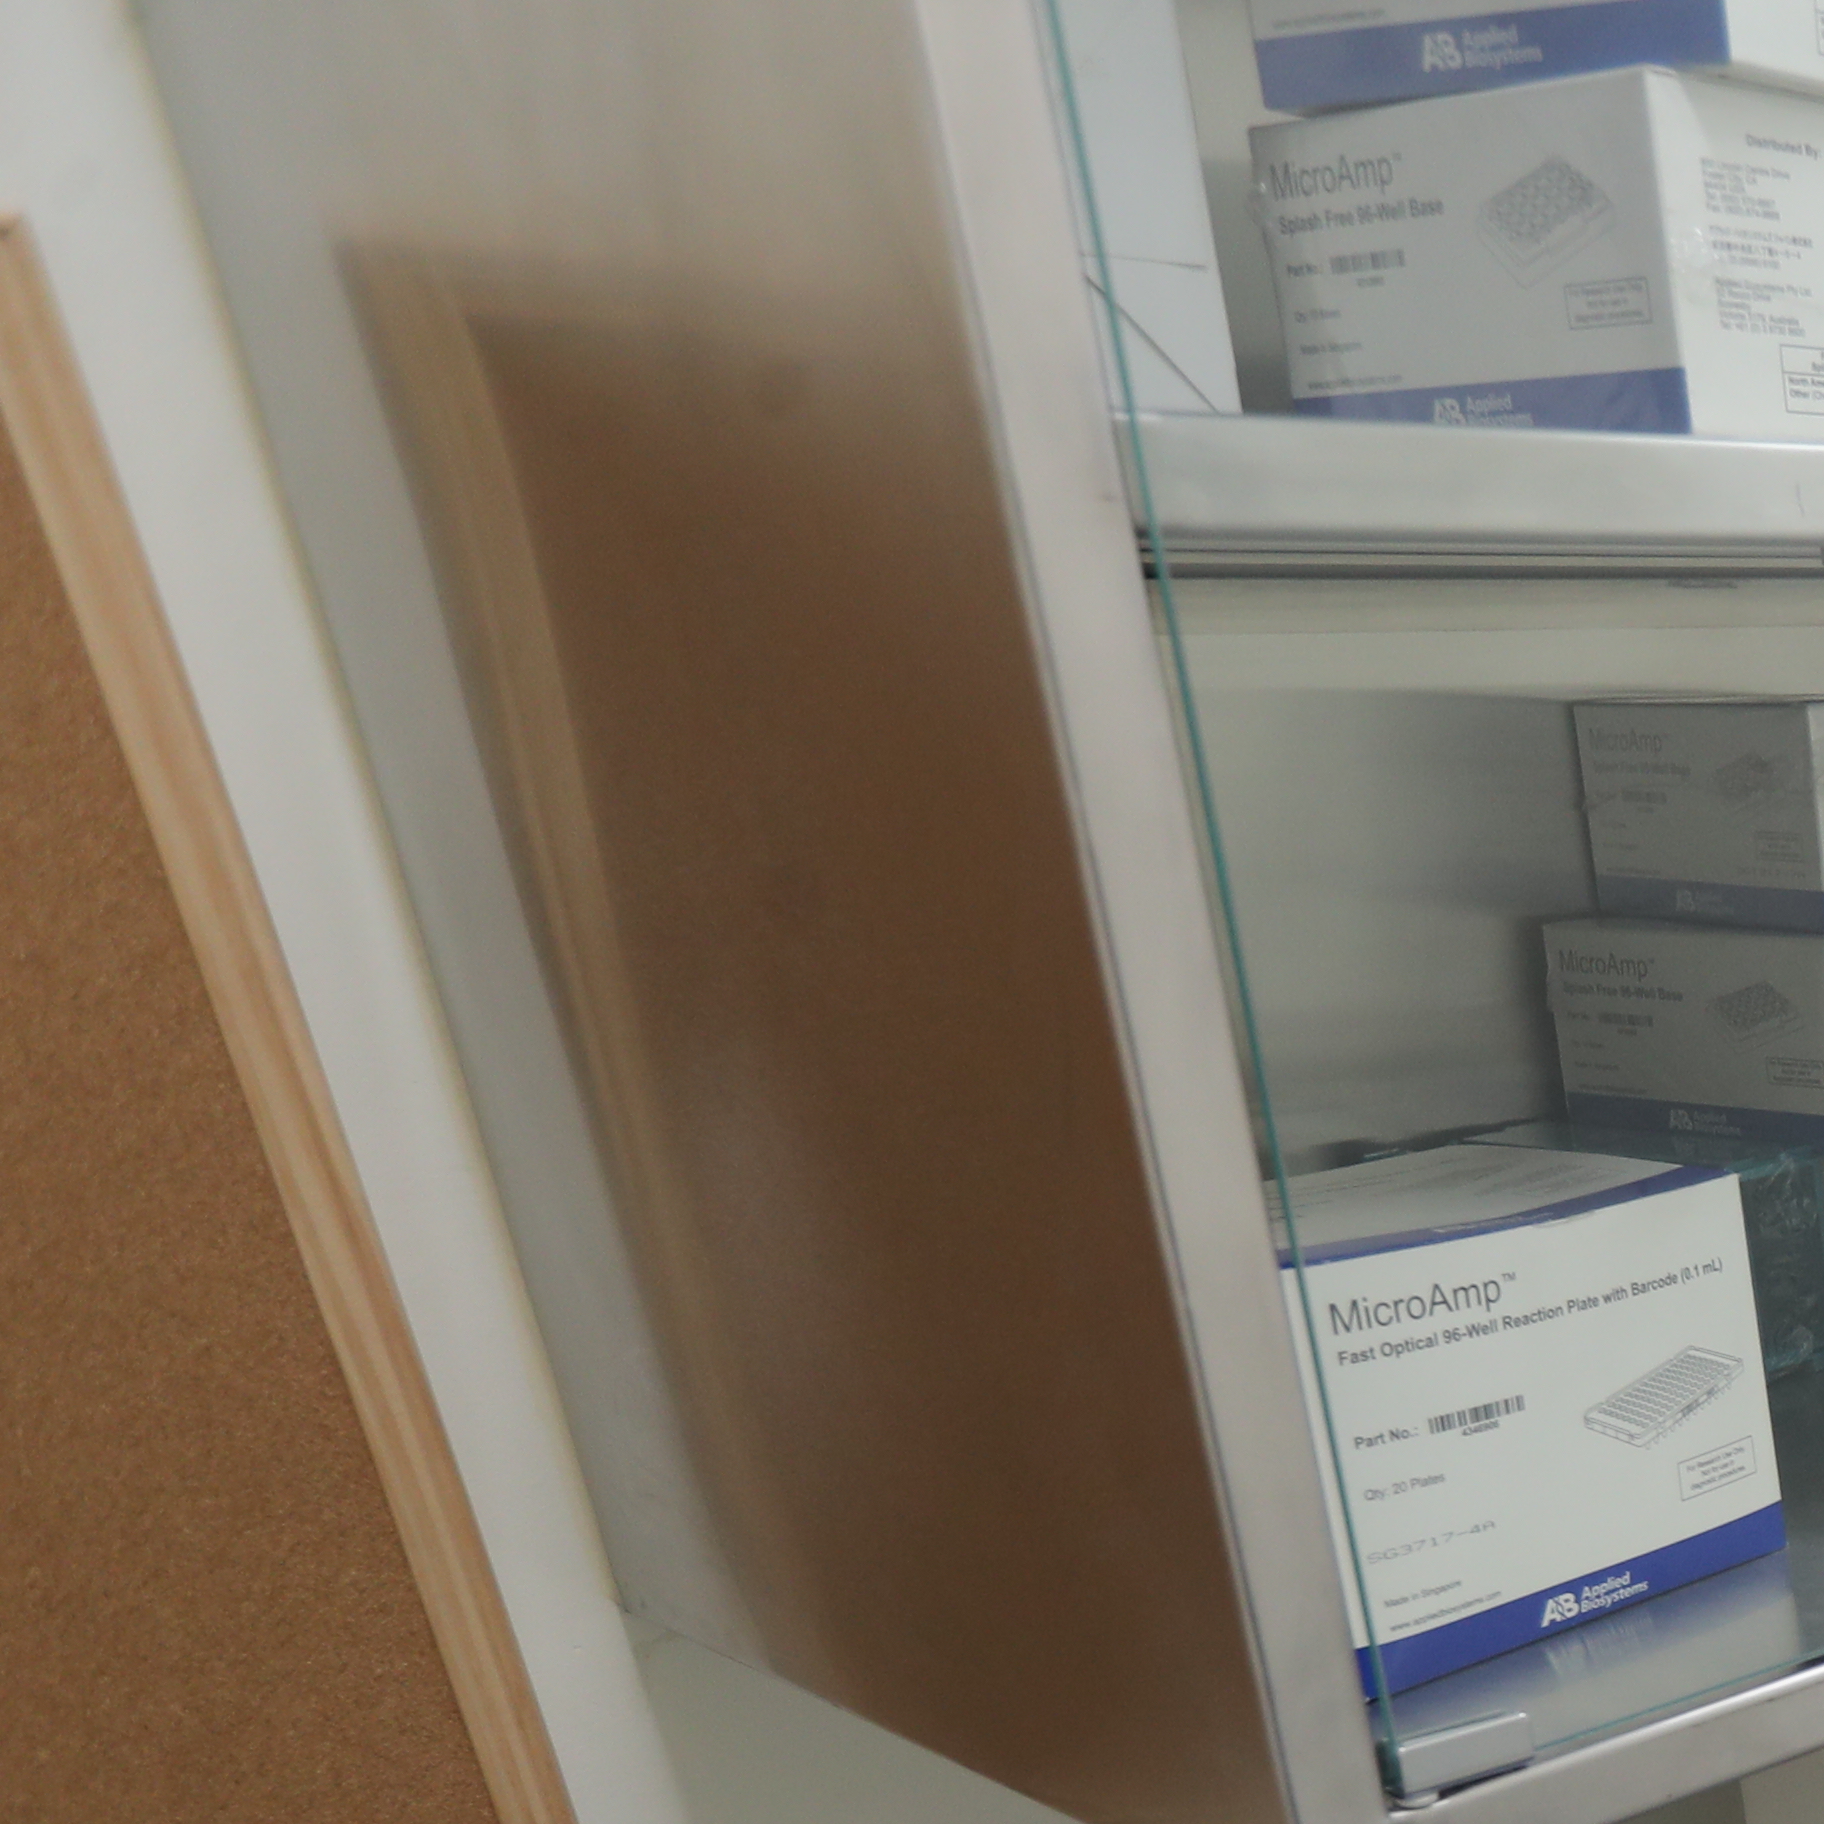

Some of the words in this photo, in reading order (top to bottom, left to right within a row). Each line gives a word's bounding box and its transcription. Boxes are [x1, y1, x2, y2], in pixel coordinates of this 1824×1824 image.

[1325, 211, 1355, 230] Free
[1409, 199, 1445, 218] Base
[1337, 1347, 1377, 1367] Fast
[1380, 1332, 1439, 1359] Optical
[1442, 1318, 1499, 1344] 96-Well
[1502, 1304, 1564, 1331] Reaction
[1566, 1294, 1600, 1315] Plate
[1602, 1285, 1629, 1305] with
[1630, 1271, 1679, 1297] Barcode
[1680, 1264, 1701, 1286] (0.1
[1702, 1256, 1723, 1276] mL)
[1353, 1433, 1386, 1450] Part
[1388, 1426, 1419, 1441] No.:
[1391, 1481, 1408, 1496] 20
[1409, 1472, 1447, 1490] Plates
[1366, 1520, 1497, 1565] SG3717-4A
[1383, 1596, 1410, 1609] Made
[1420, 1579, 1463, 1599] Singapore
[1541, 1591, 1581, 1628] AB
[1581, 1570, 1632, 1600] Applied
[1581, 1580, 1650, 1614] Biosystems
